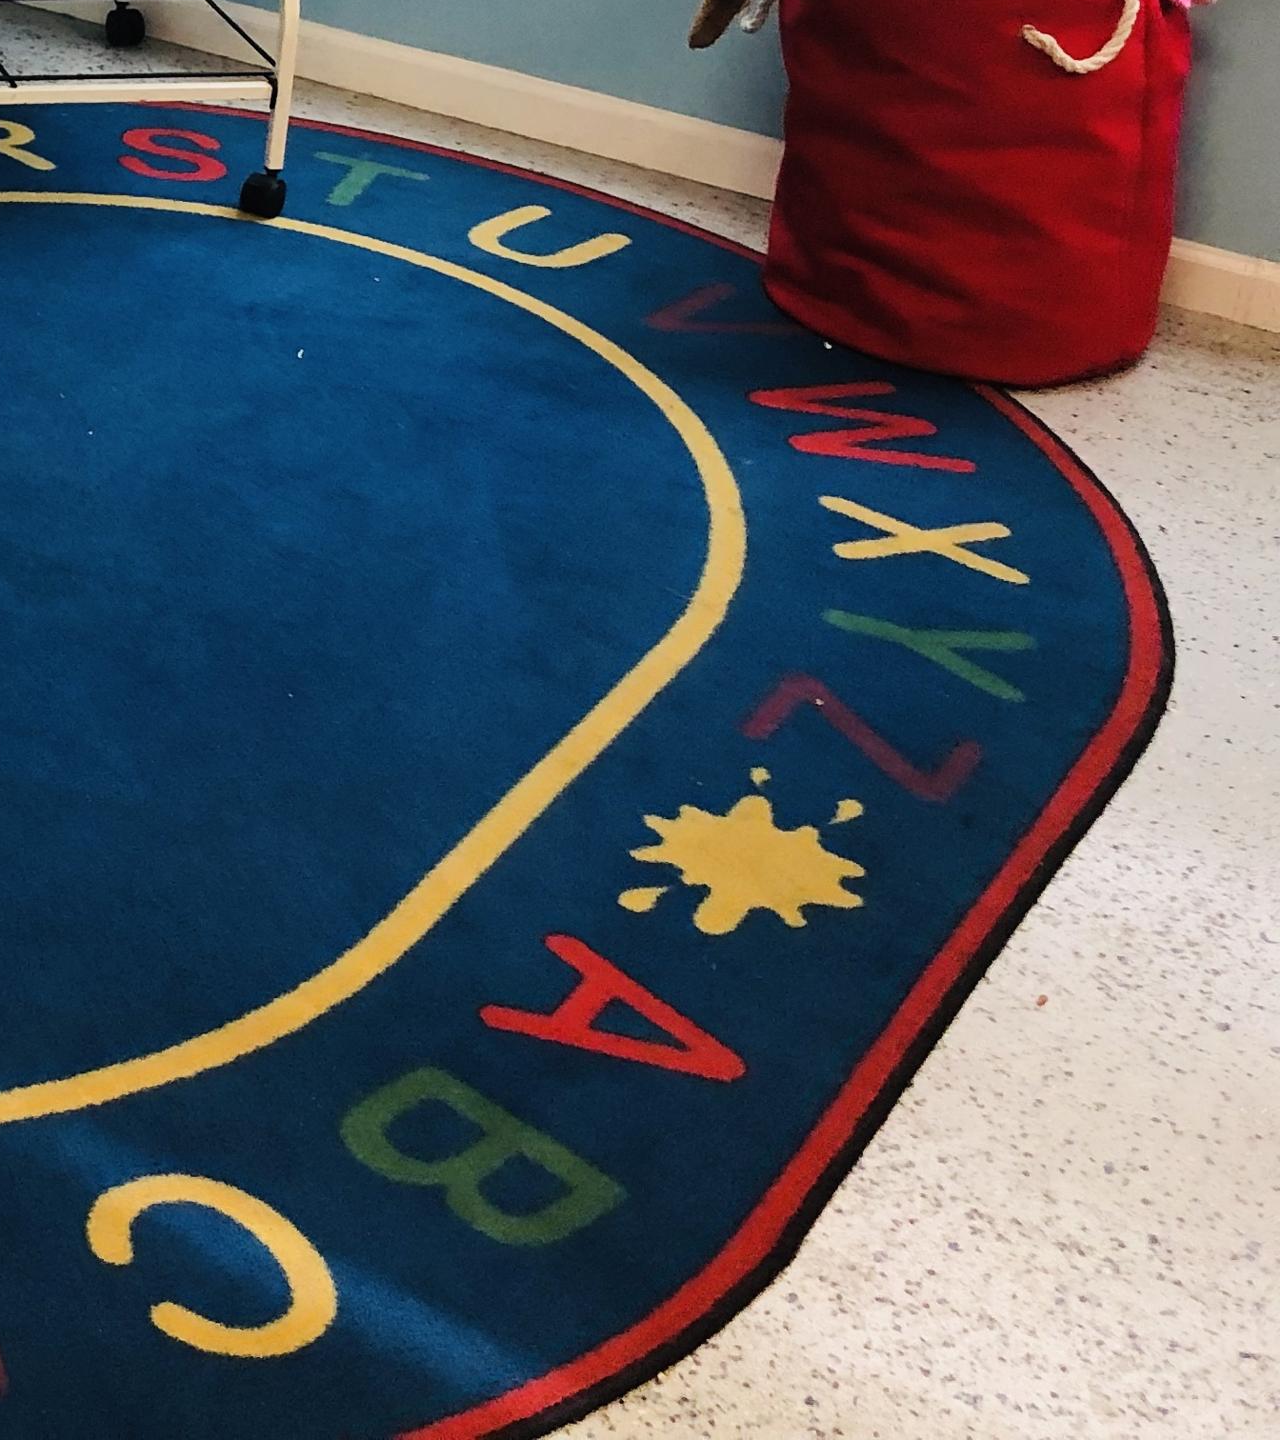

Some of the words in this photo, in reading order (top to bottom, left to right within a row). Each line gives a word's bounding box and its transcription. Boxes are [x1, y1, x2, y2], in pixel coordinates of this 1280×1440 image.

[117, 127, 228, 182] S
[314, 151, 430, 206] T
[468, 204, 632, 269] U
[748, 381, 976, 474] W
[819, 495, 1031, 585] X
[822, 609, 1035, 703] Y
[739, 673, 982, 803] Z
[479, 934, 748, 1083] A
[339, 1066, 627, 1247] B
[86, 1172, 338, 1358] C
